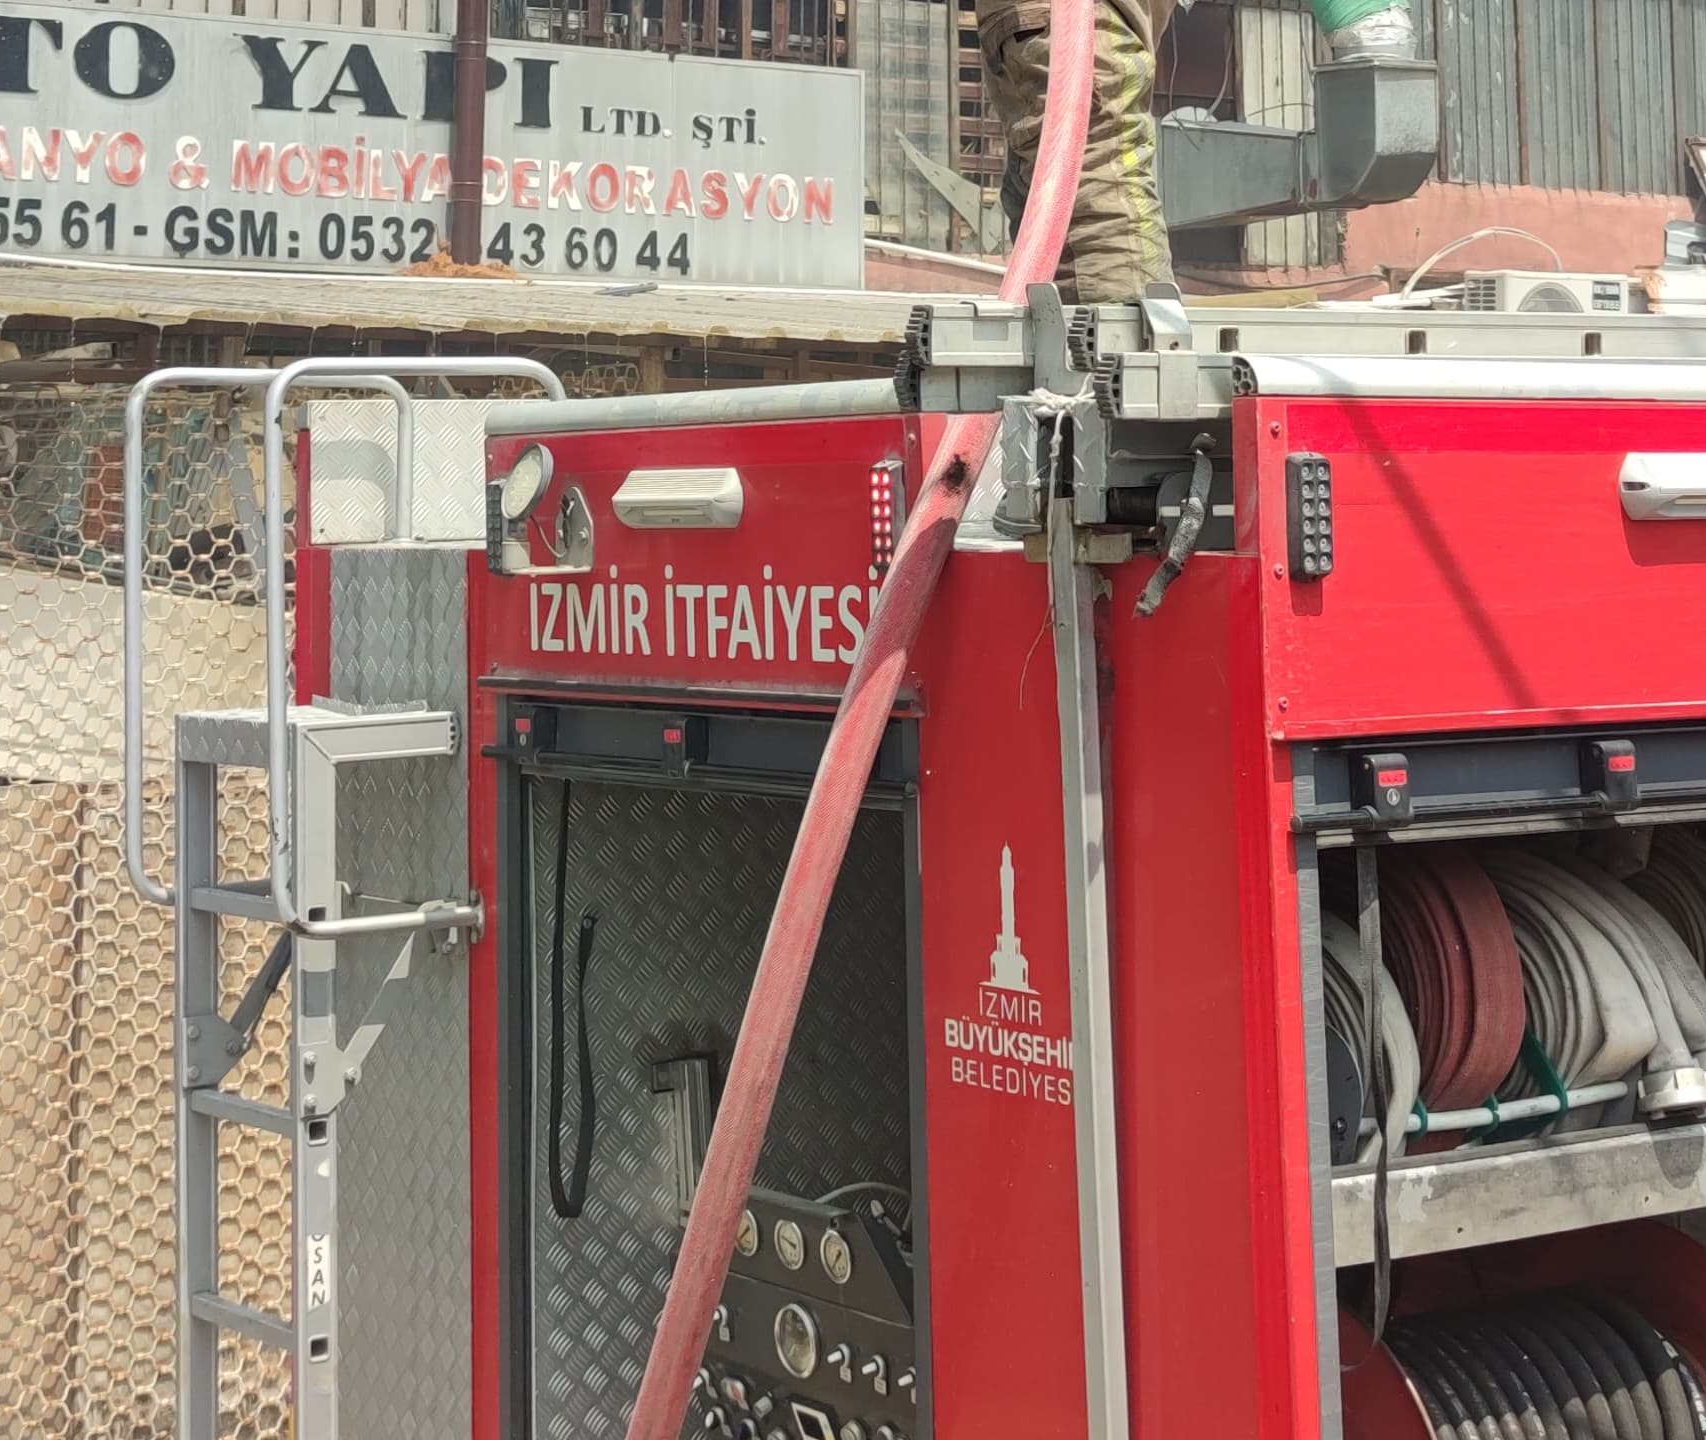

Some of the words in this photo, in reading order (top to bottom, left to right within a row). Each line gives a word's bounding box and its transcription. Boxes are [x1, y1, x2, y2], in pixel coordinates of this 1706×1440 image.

[581, 106, 673, 139] LTD.
[169, 135, 210, 189] &
[231, 136, 453, 204] MOBİLYA
[482, 156, 835, 226] DEKORASYON
[60, 203, 115, 250] 61
[318, 213, 435, 264] 0532
[564, 226, 618, 272] 60
[636, 230, 692, 277] 44
